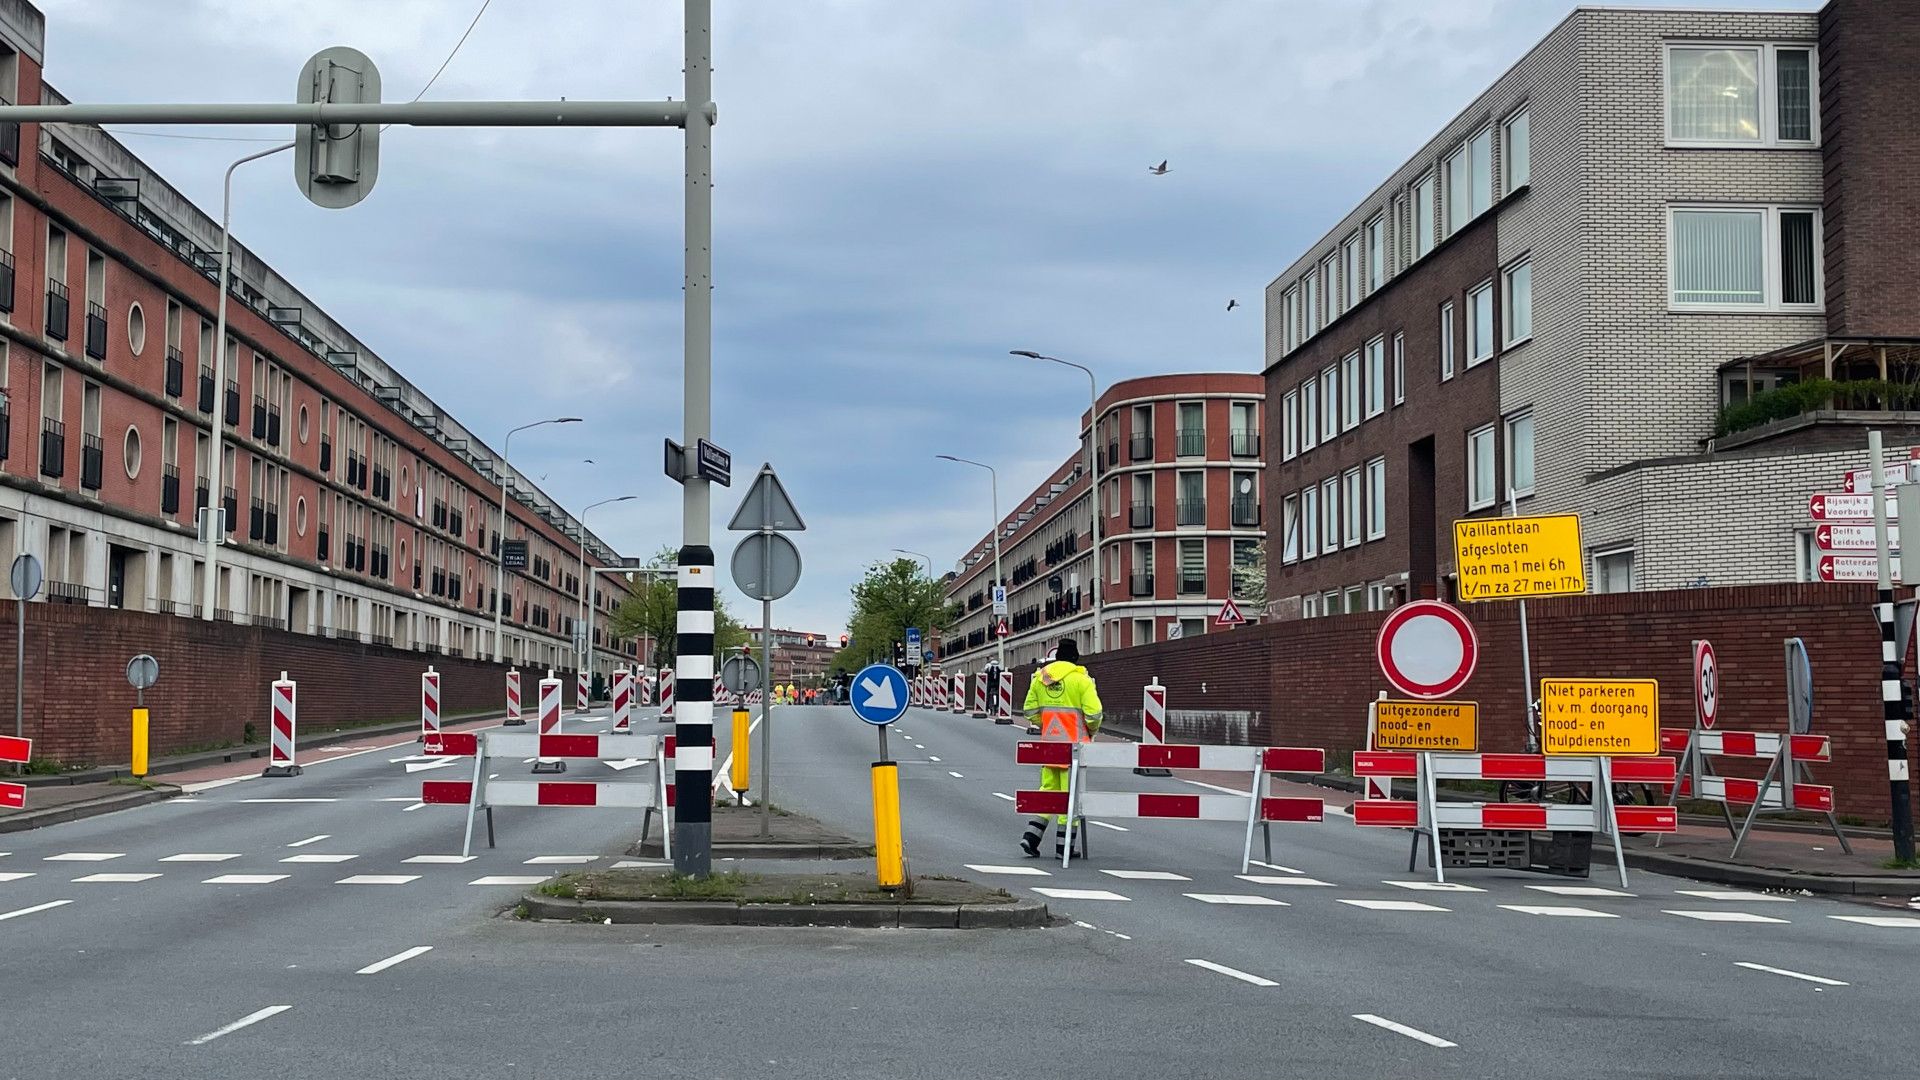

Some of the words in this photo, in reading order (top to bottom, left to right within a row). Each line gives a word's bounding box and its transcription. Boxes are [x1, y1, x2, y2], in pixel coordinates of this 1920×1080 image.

[1827, 498, 1861, 506] Rijswijk
[1460, 522, 1540, 537] Vaillantlaan
[1462, 541, 1528, 559] afgesloten
[1463, 564, 1486, 576] van
[1491, 562, 1510, 574] ma
[1513, 560, 1518, 573] 1
[1522, 558, 1545, 573] mei
[1549, 558, 1565, 571] 6h
[1464, 582, 1491, 596] t/m
[1495, 582, 1509, 593] za
[1513, 579, 1528, 592] 27
[1533, 578, 1556, 591] mei
[1561, 577, 1580, 590] 17h
[1703, 666, 1714, 702] 30
[1548, 685, 1575, 697] Niet
[1579, 685, 1635, 699] parkeren
[1380, 705, 1460, 718] uitgezonderd
[1548, 702, 1586, 713] i.v.m.
[1590, 702, 1648, 717] doorgang
[1380, 720, 1414, 730] nood-
[1417, 721, 1431, 731] en
[1548, 719, 1585, 730] nood-
[1590, 721, 1605, 730] en
[1380, 734, 1460, 746] hulpdiensten
[1548, 735, 1631, 748] hulpdiensten
